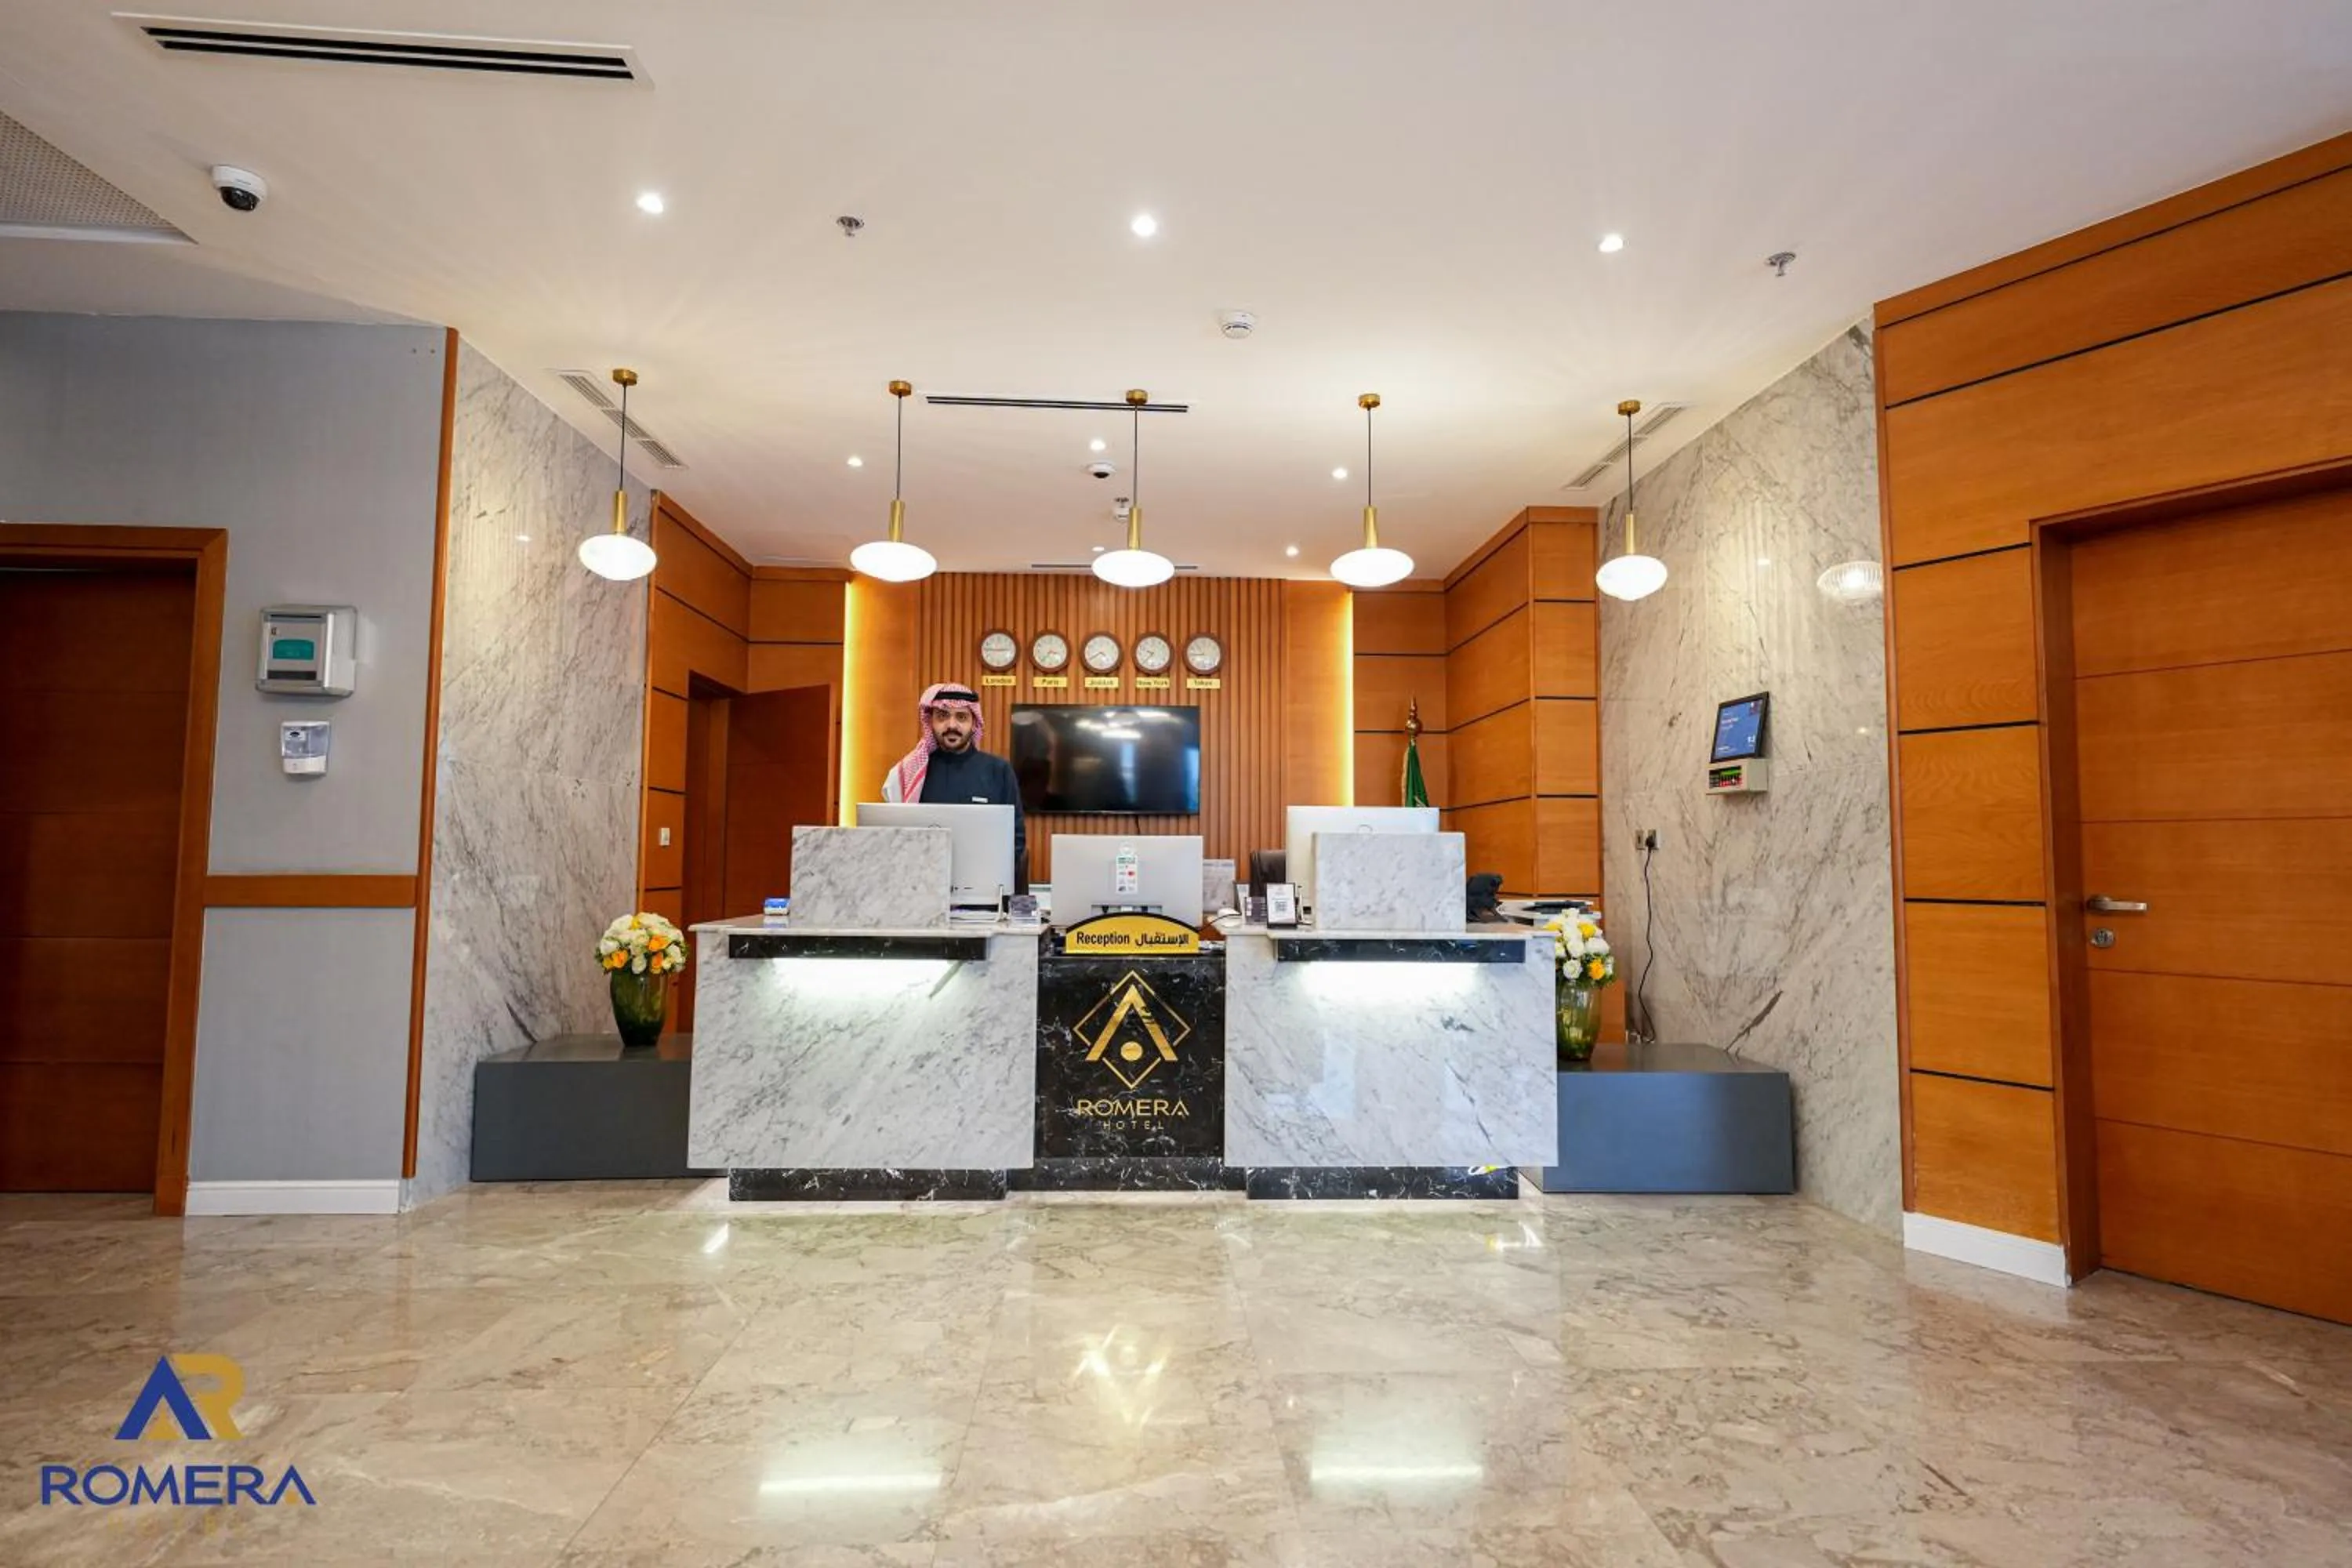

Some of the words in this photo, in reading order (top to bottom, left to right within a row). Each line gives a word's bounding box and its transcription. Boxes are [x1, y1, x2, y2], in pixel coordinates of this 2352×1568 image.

[1076, 931, 1130, 946] Reception
[1077, 1098, 1189, 1116] ROMERA
[1103, 1120, 1164, 1130] HOTEL
